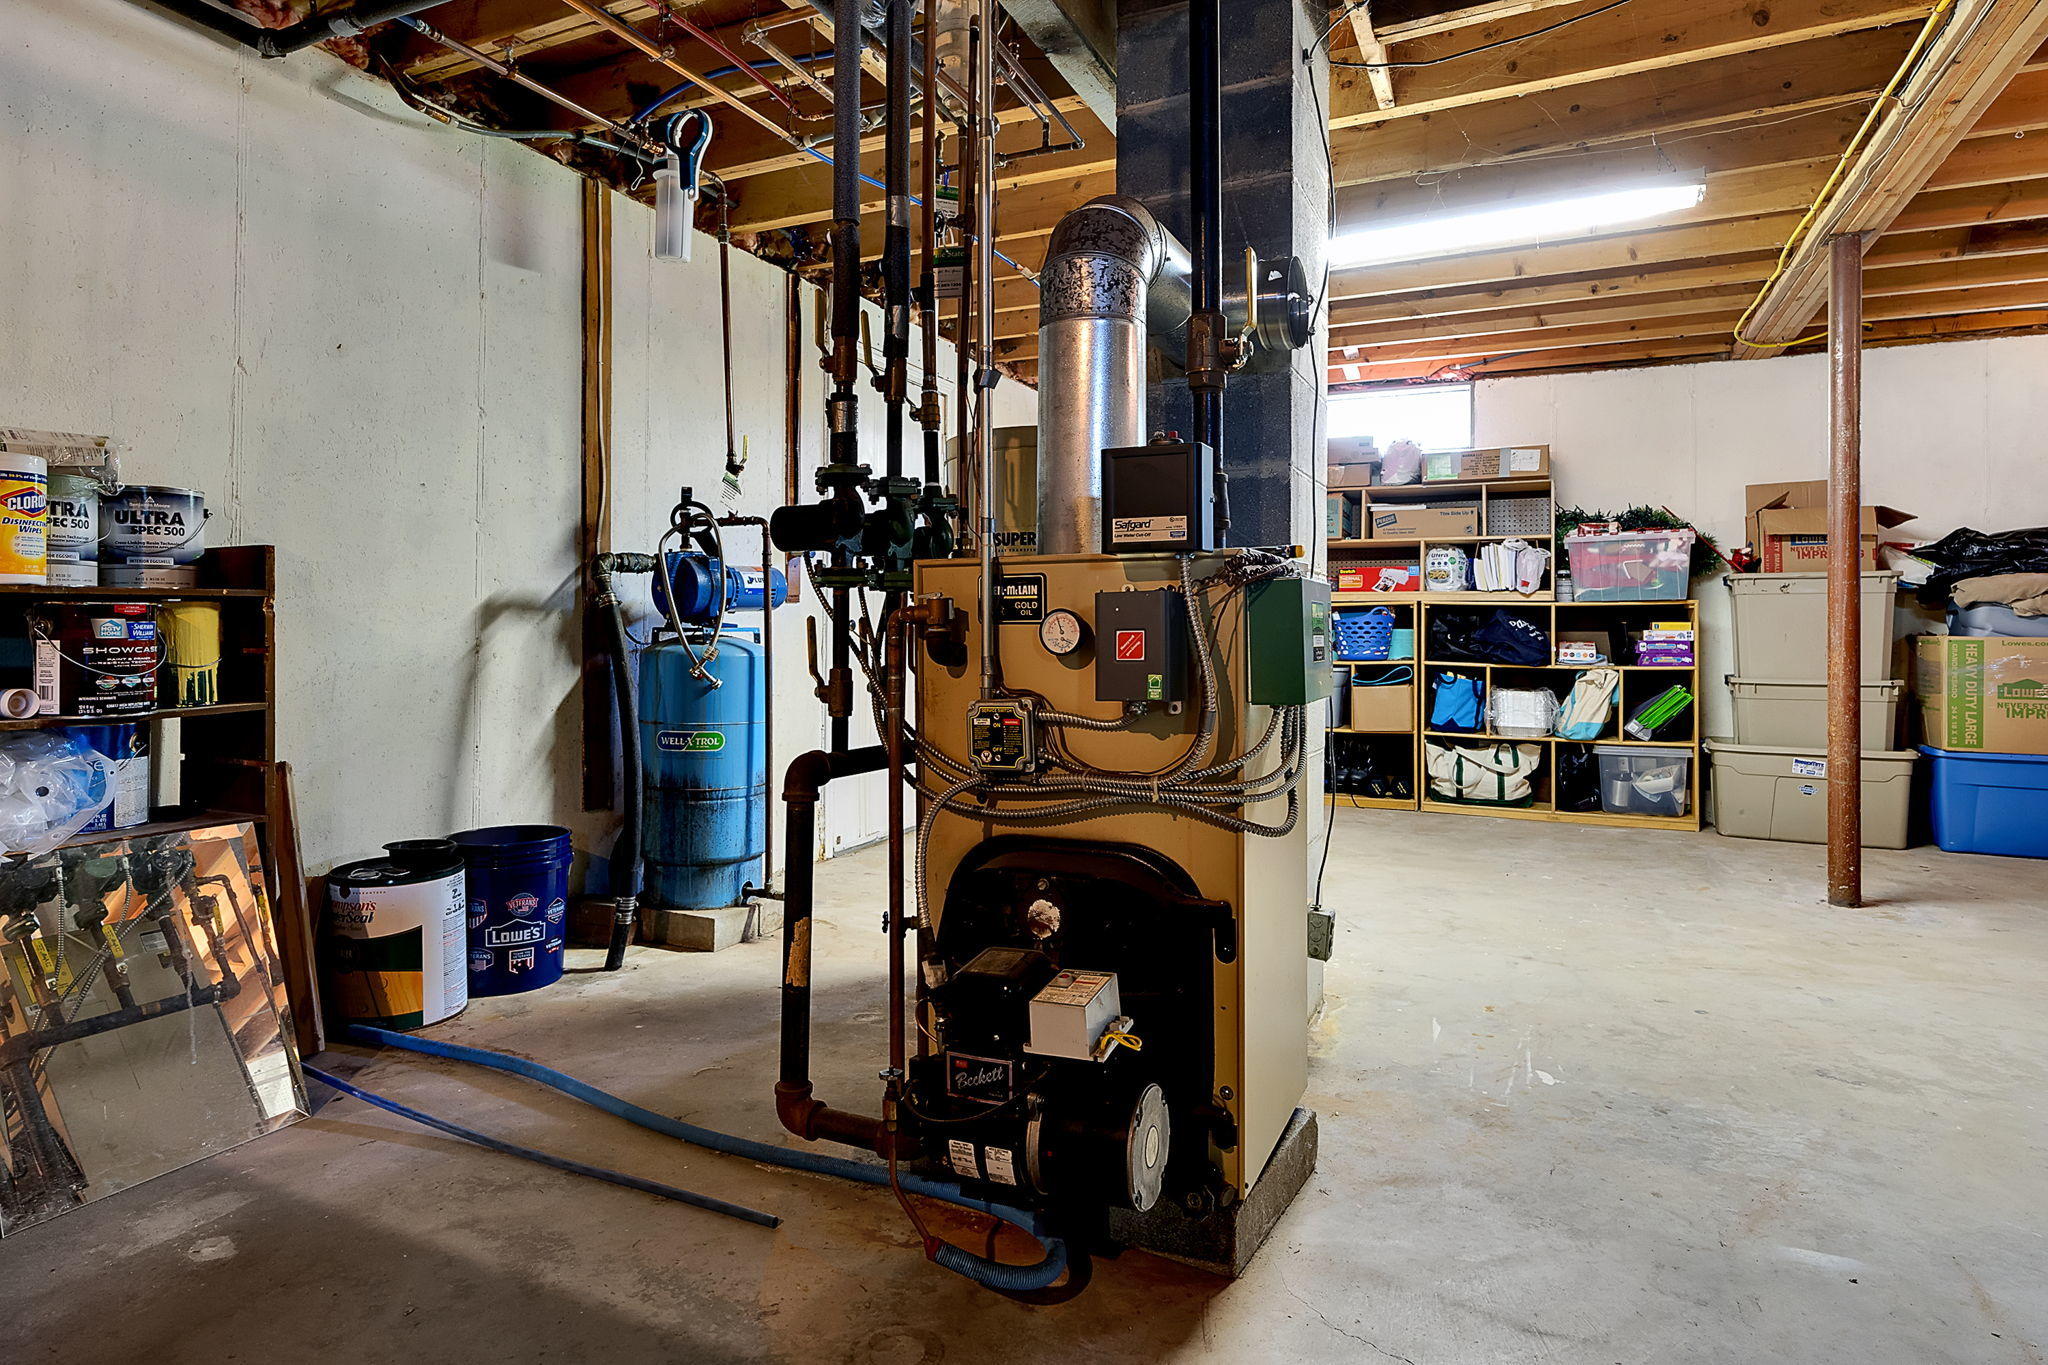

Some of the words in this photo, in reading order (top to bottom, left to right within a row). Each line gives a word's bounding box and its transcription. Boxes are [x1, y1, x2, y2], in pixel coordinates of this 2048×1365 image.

[46, 500, 90, 519] TRA
[46, 517, 68, 528] PEC
[71, 519, 90, 530] 500
[114, 509, 186, 527] ULTRA
[19, 525, 42, 535] WIPES
[130, 526, 161, 536] SPEC
[164, 527, 186, 537] 500
[1114, 519, 1152, 532] Safgard
[993, 531, 1037, 547] SUPER
[1795, 534, 1828, 544] LOWE
[1014, 601, 1038, 609] GOLD
[1965, 643, 1978, 678] HEAVY
[1965, 681, 1978, 709] DUTY
[2004, 686, 2048, 698] LOWE
[1996, 702, 2030, 710] NEVER
[2032, 702, 2048, 710] STO
[2006, 708, 2048, 719] IMPR
[1965, 711, 1978, 745] LARGE
[492, 926, 541, 943] LOWE'S
[955, 1066, 1004, 1090] Beckett
